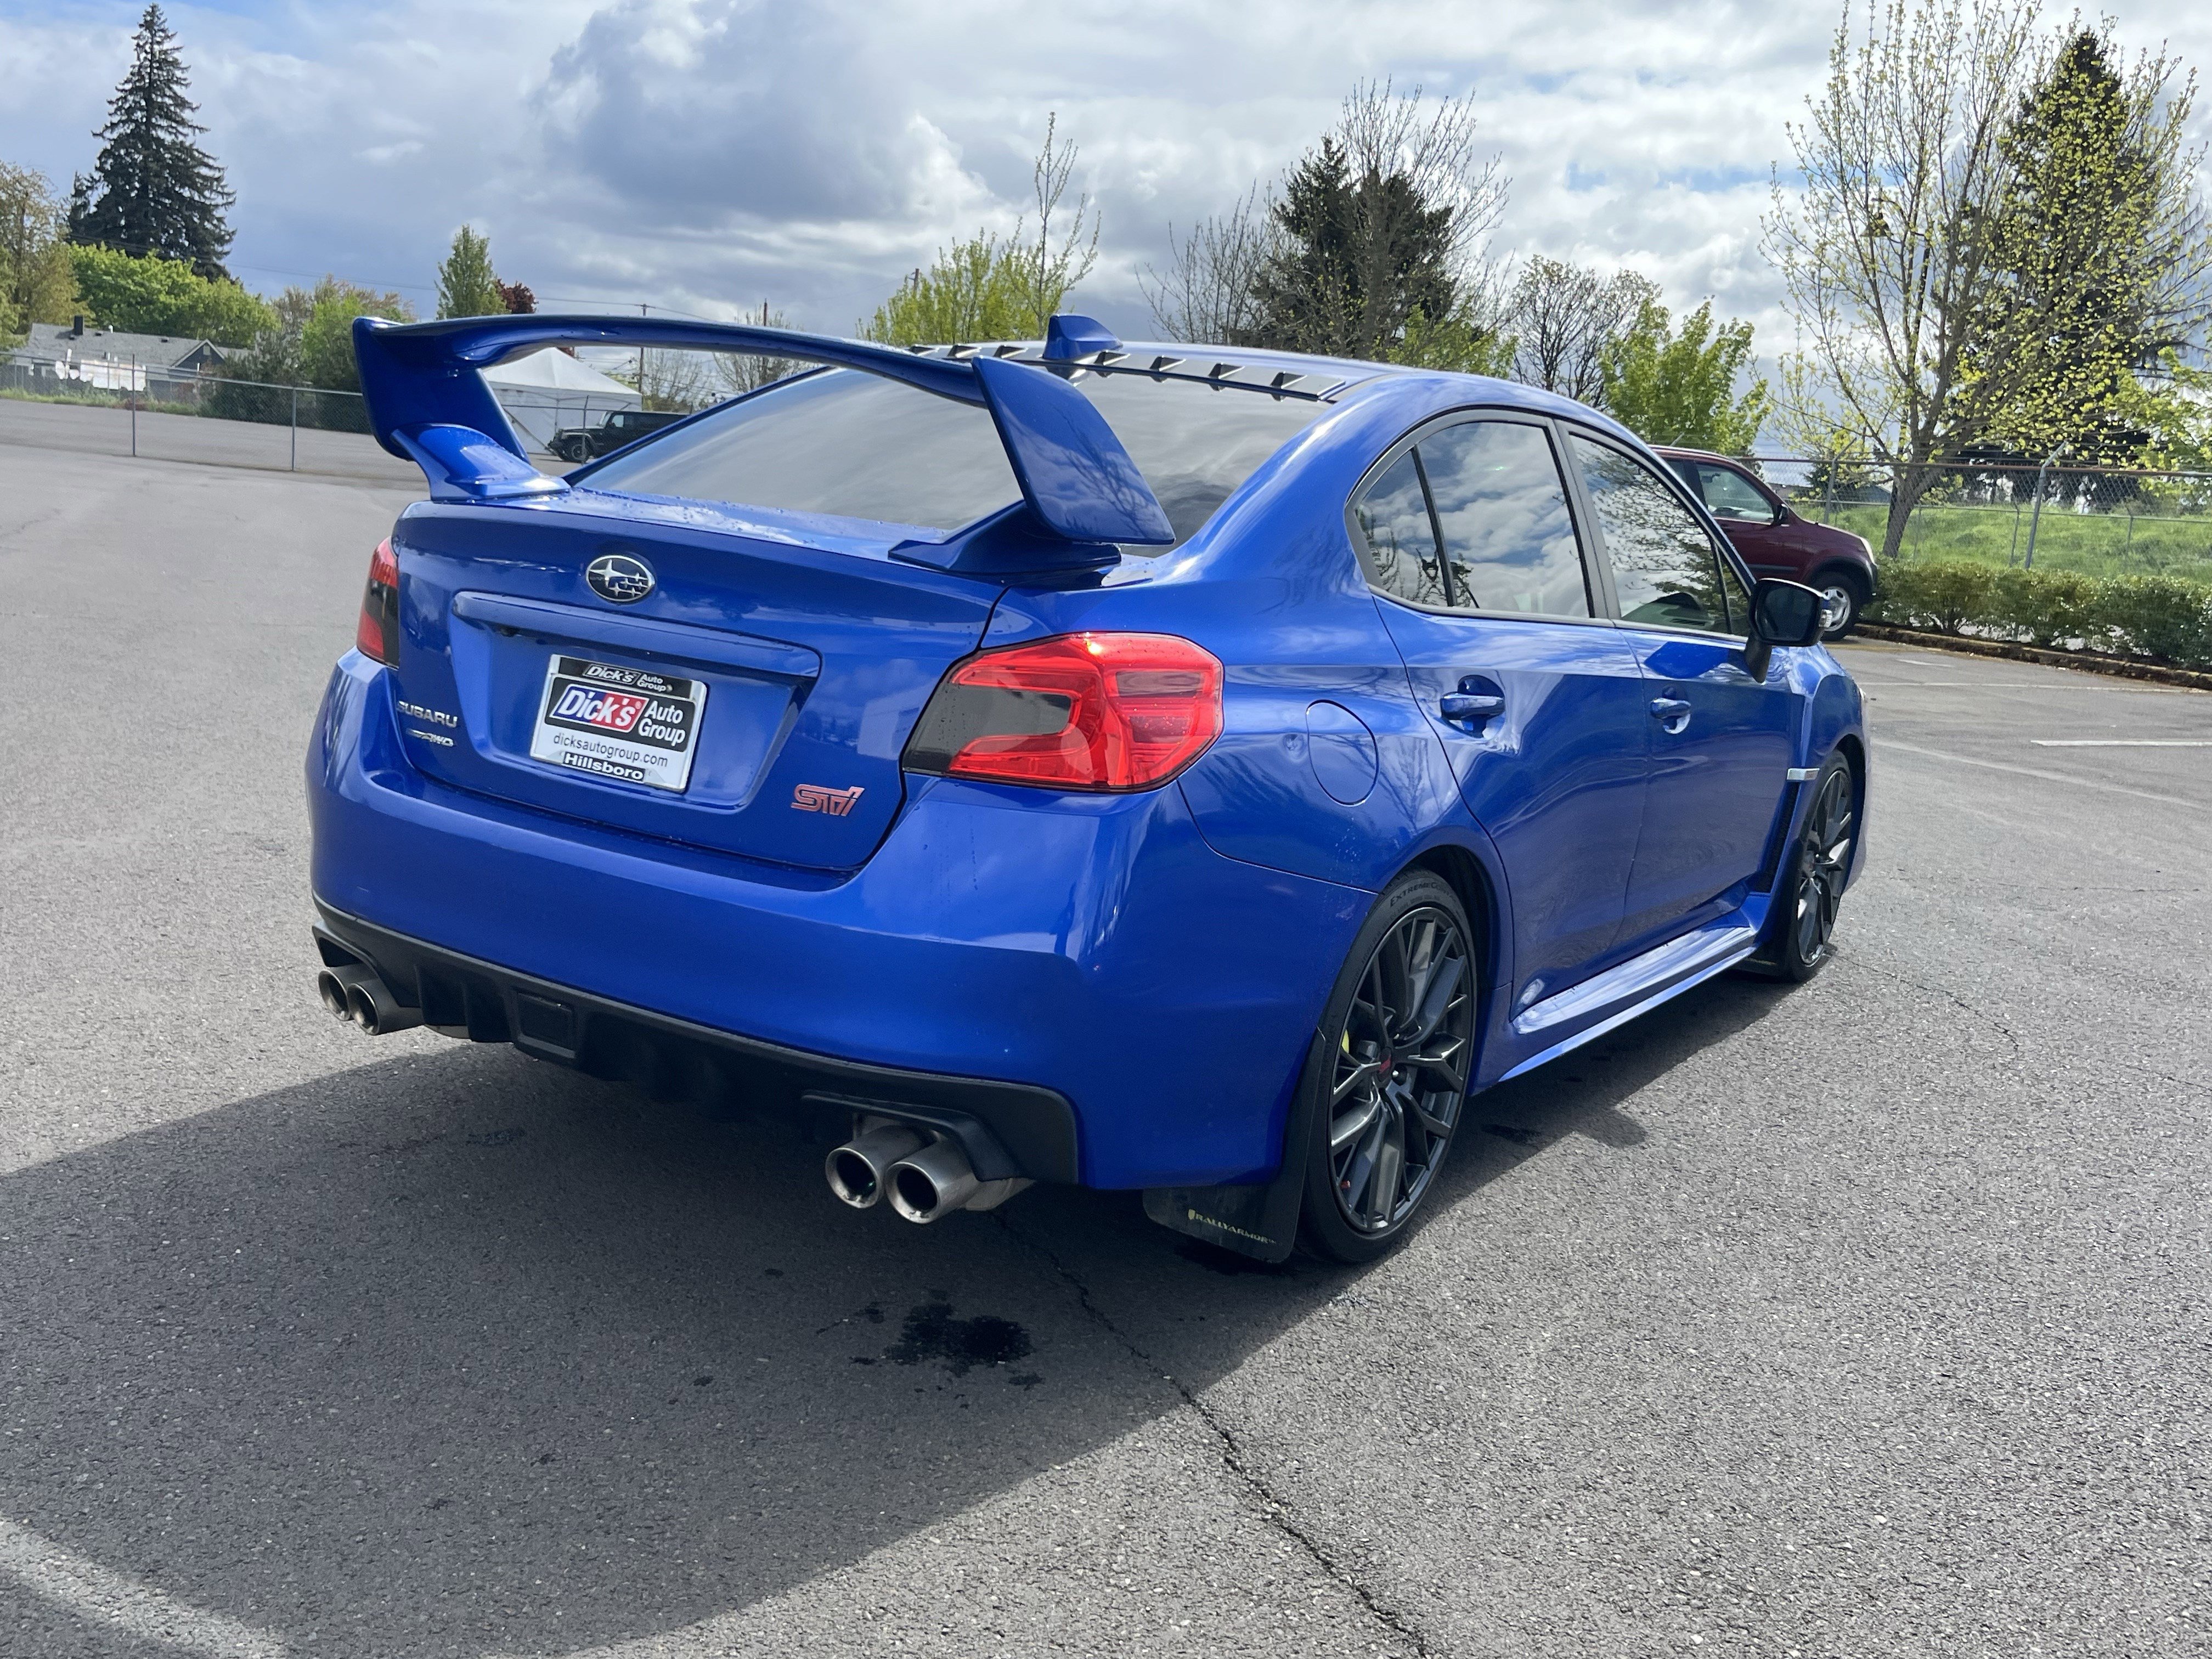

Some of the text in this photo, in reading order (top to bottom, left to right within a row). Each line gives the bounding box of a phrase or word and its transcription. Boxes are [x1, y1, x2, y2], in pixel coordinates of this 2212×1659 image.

[587, 665, 634, 682] Dick's
[636, 680, 667, 692] Group
[641, 674, 663, 684] Auto
[396, 701, 458, 728] SUBARU
[558, 689, 635, 727] Dick's
[645, 701, 684, 724] Auto
[638, 719, 686, 746] Group
[553, 733, 668, 768] dicksautogroup.com
[564, 752, 644, 780] Hillsboro
